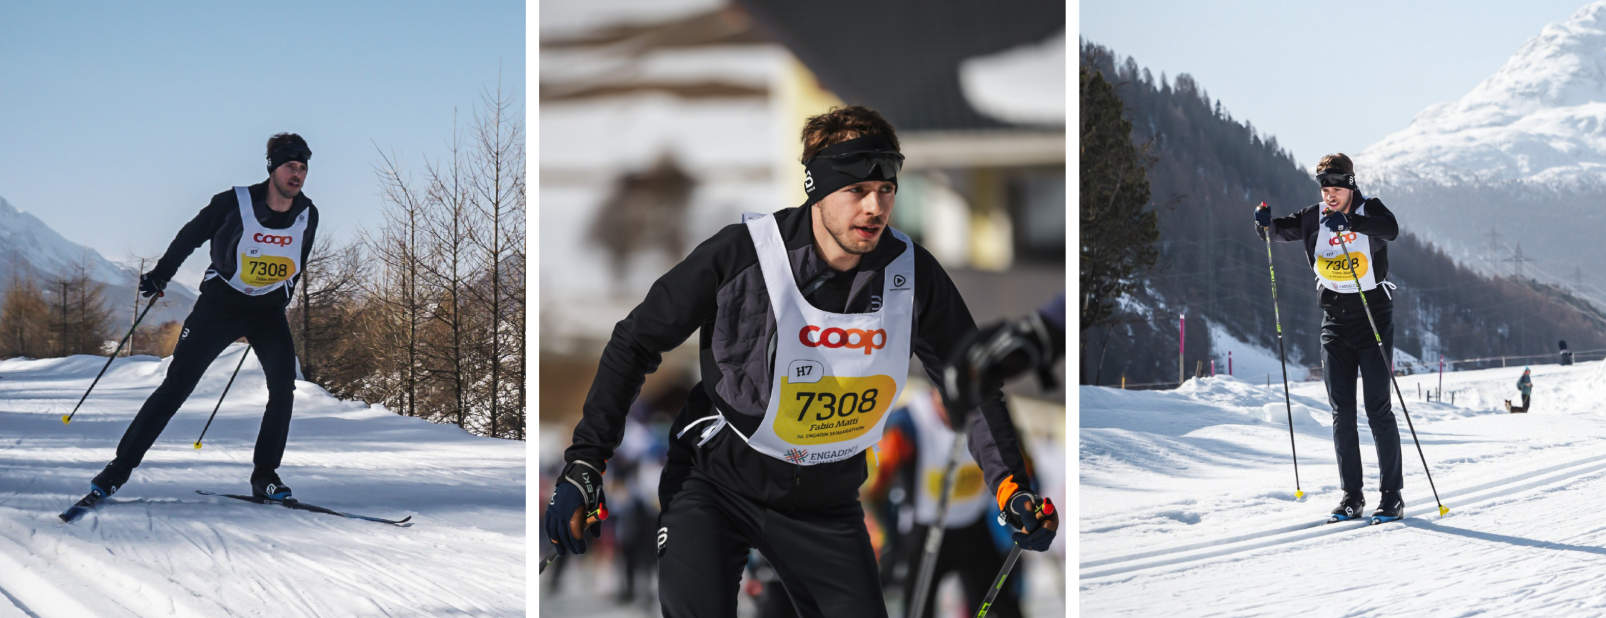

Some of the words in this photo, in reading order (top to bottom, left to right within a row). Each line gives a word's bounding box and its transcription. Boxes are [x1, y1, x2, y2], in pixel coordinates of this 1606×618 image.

[249, 260, 288, 278] 7308
[1325, 257, 1360, 271] 7308
[799, 325, 887, 355] coop
[796, 365, 813, 377] H7
[796, 388, 879, 422] 7308
[809, 422, 834, 432] Fabio
[835, 417, 860, 428] Matti
[810, 446, 855, 461] ENGADIN
